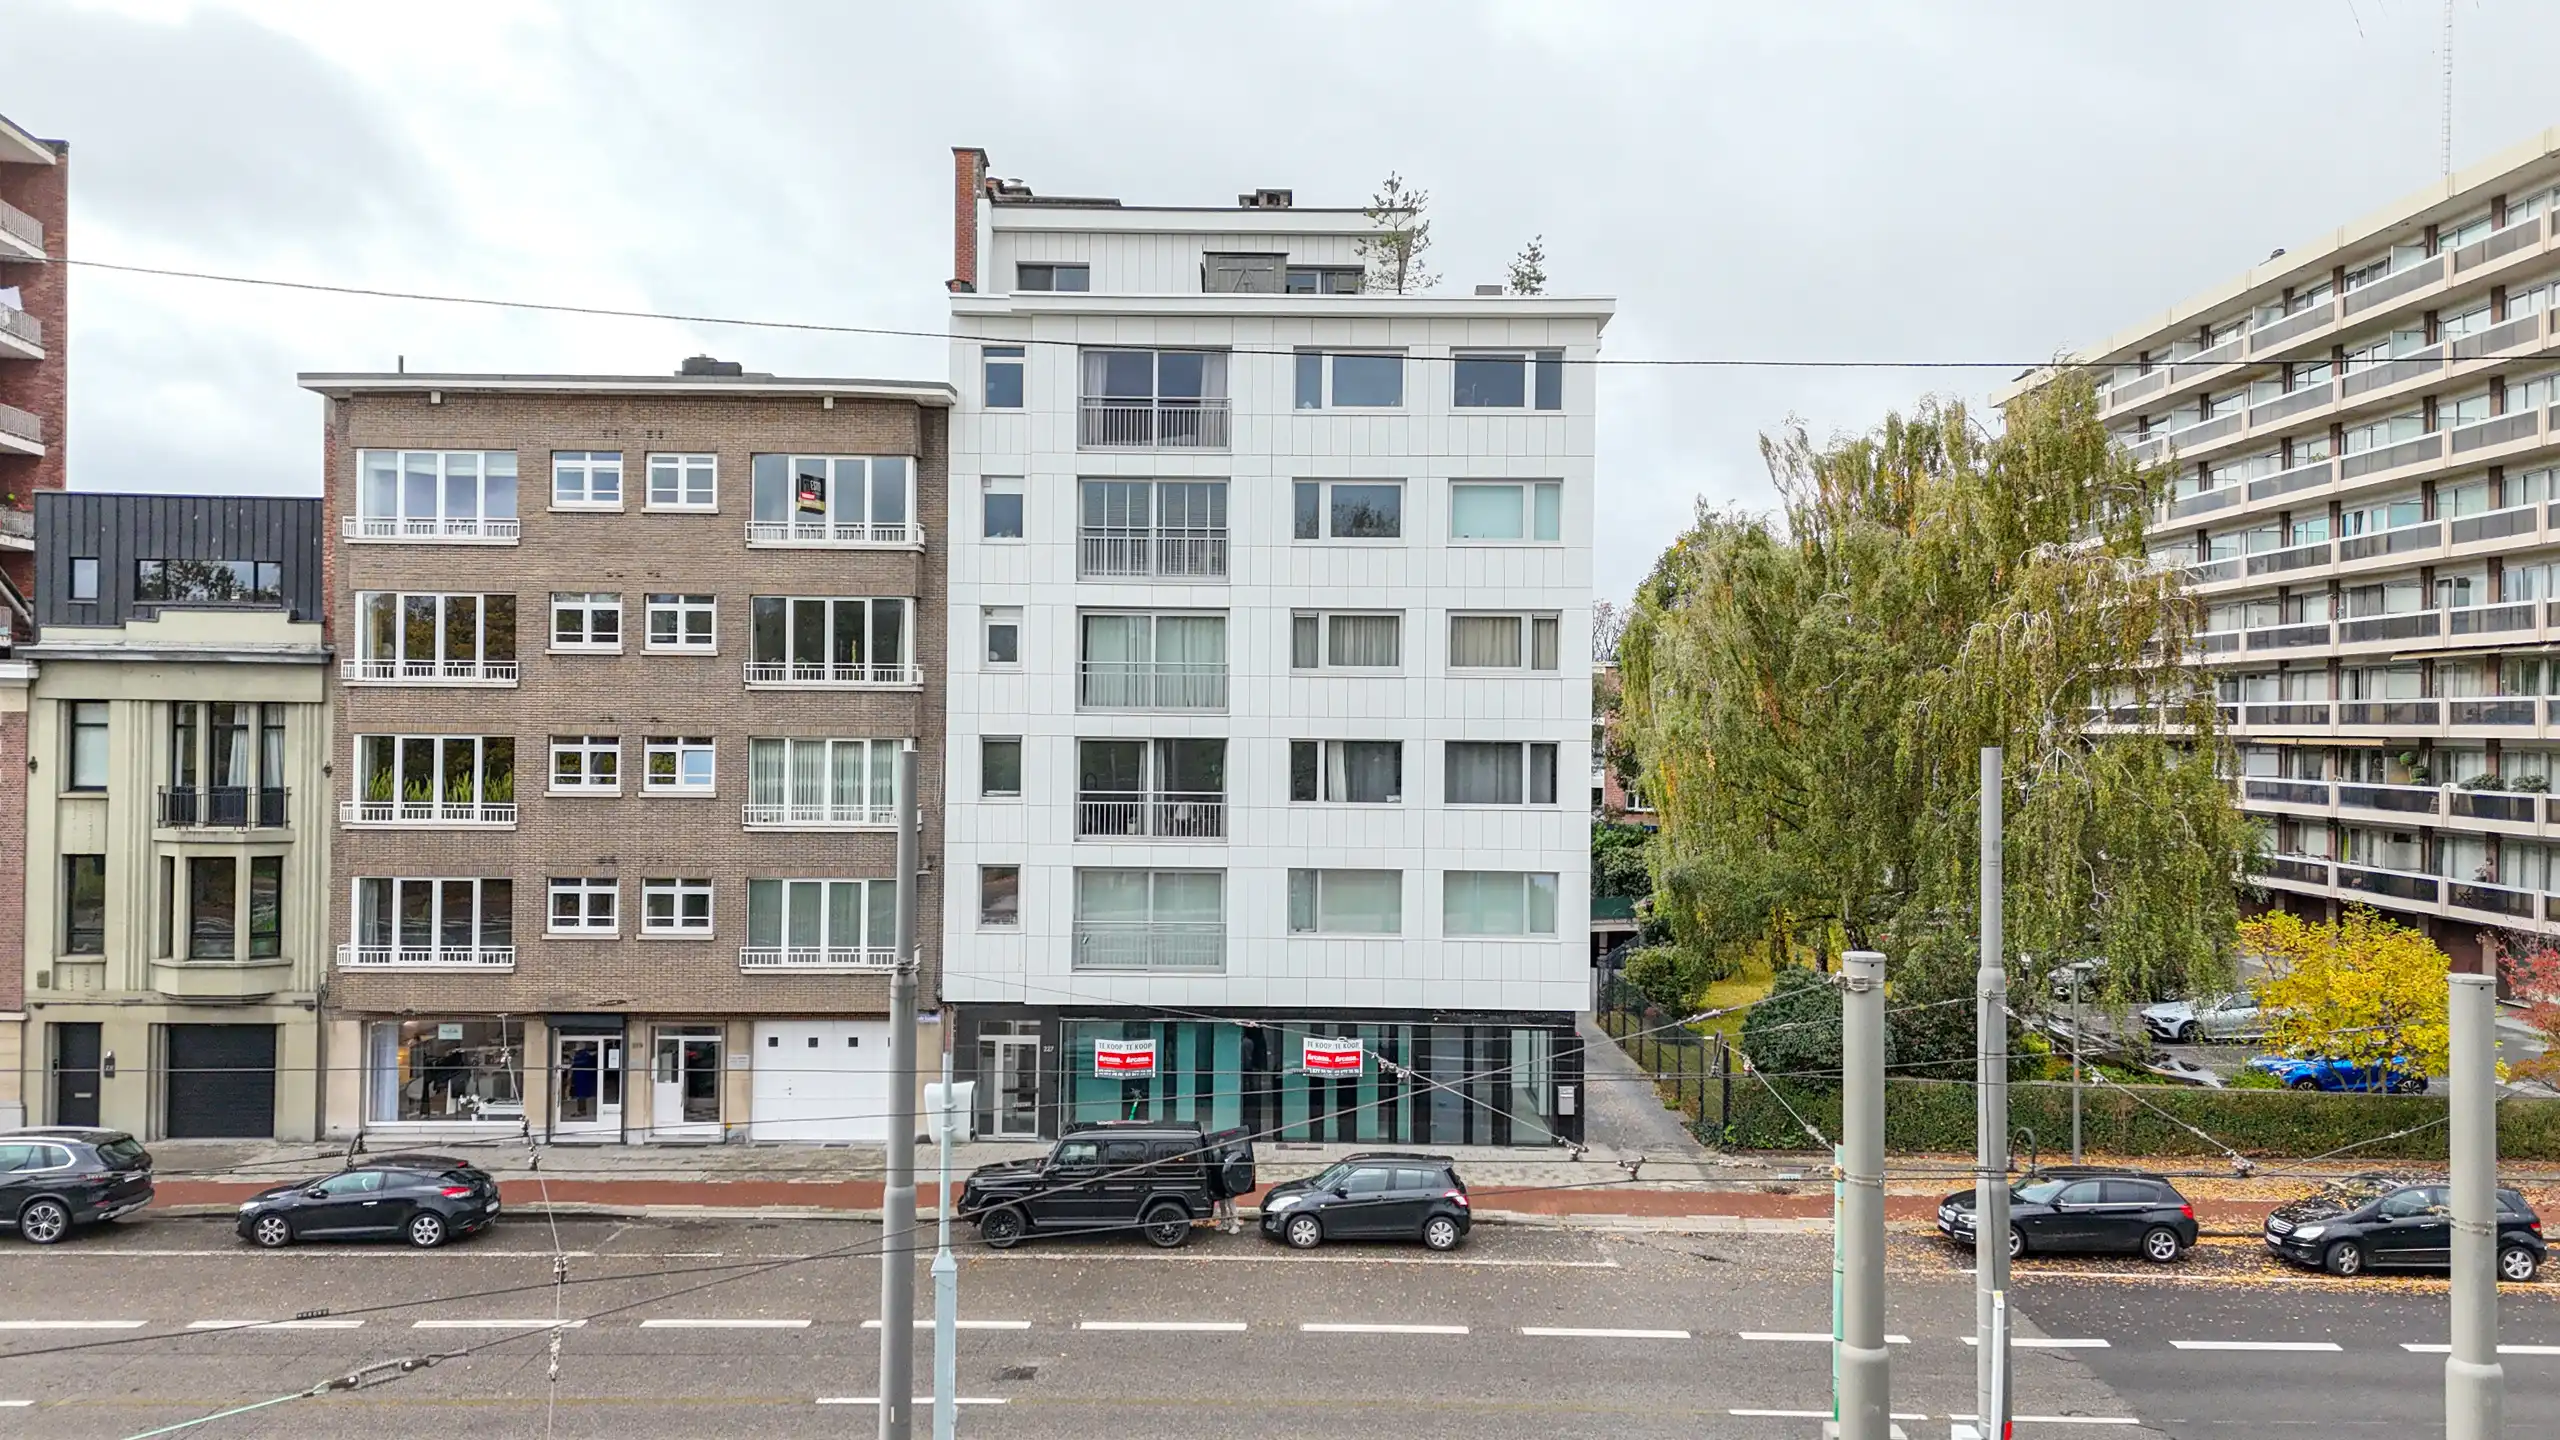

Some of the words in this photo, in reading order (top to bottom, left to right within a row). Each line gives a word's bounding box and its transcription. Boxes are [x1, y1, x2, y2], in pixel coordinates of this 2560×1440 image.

[1126, 1043, 1132, 1051] TE
[1134, 1042, 1152, 1050] KOOP
[1315, 1042, 1332, 1050] KOOP
